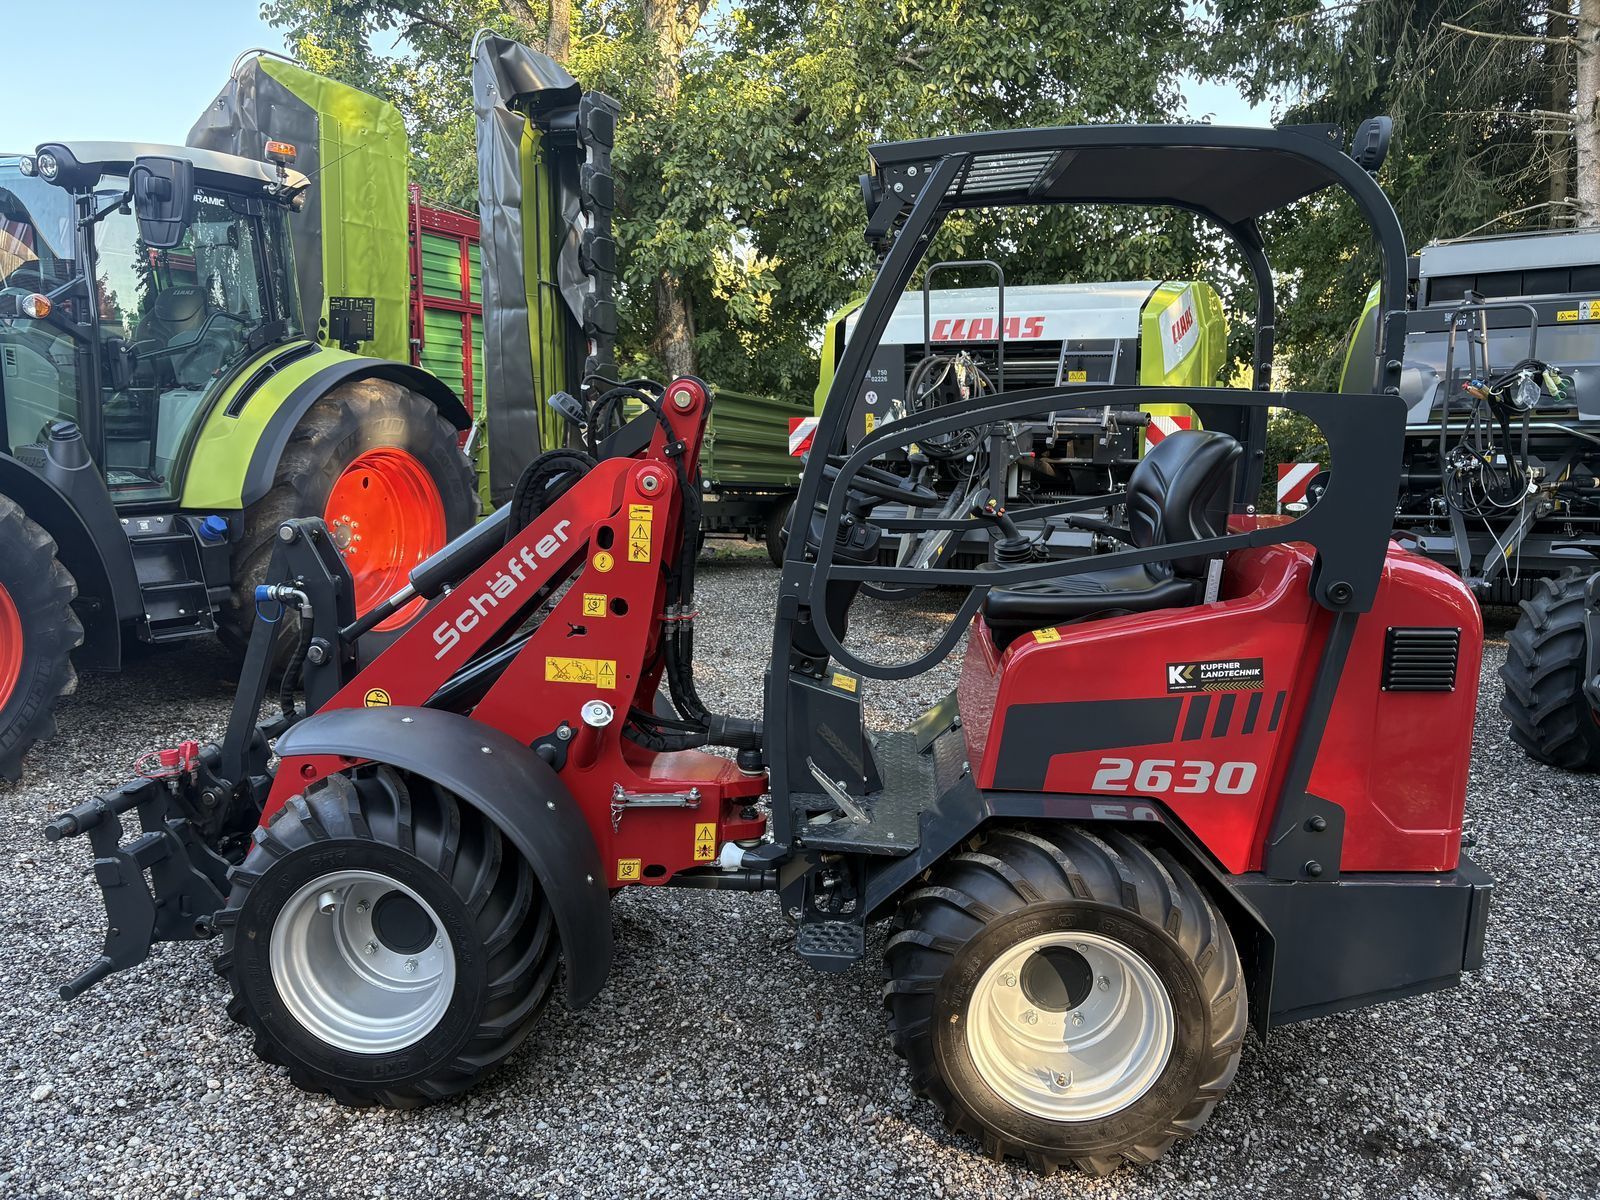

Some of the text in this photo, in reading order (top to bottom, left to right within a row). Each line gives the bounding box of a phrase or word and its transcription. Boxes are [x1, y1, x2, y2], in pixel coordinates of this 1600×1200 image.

[931, 316, 1046, 340] CLAAS
[432, 519, 571, 661] Schäffer
[1200, 662, 1240, 671] KUPFNER
[1200, 669, 1261, 679] LANDTECHNIK
[1091, 757, 1258, 795] 2630
